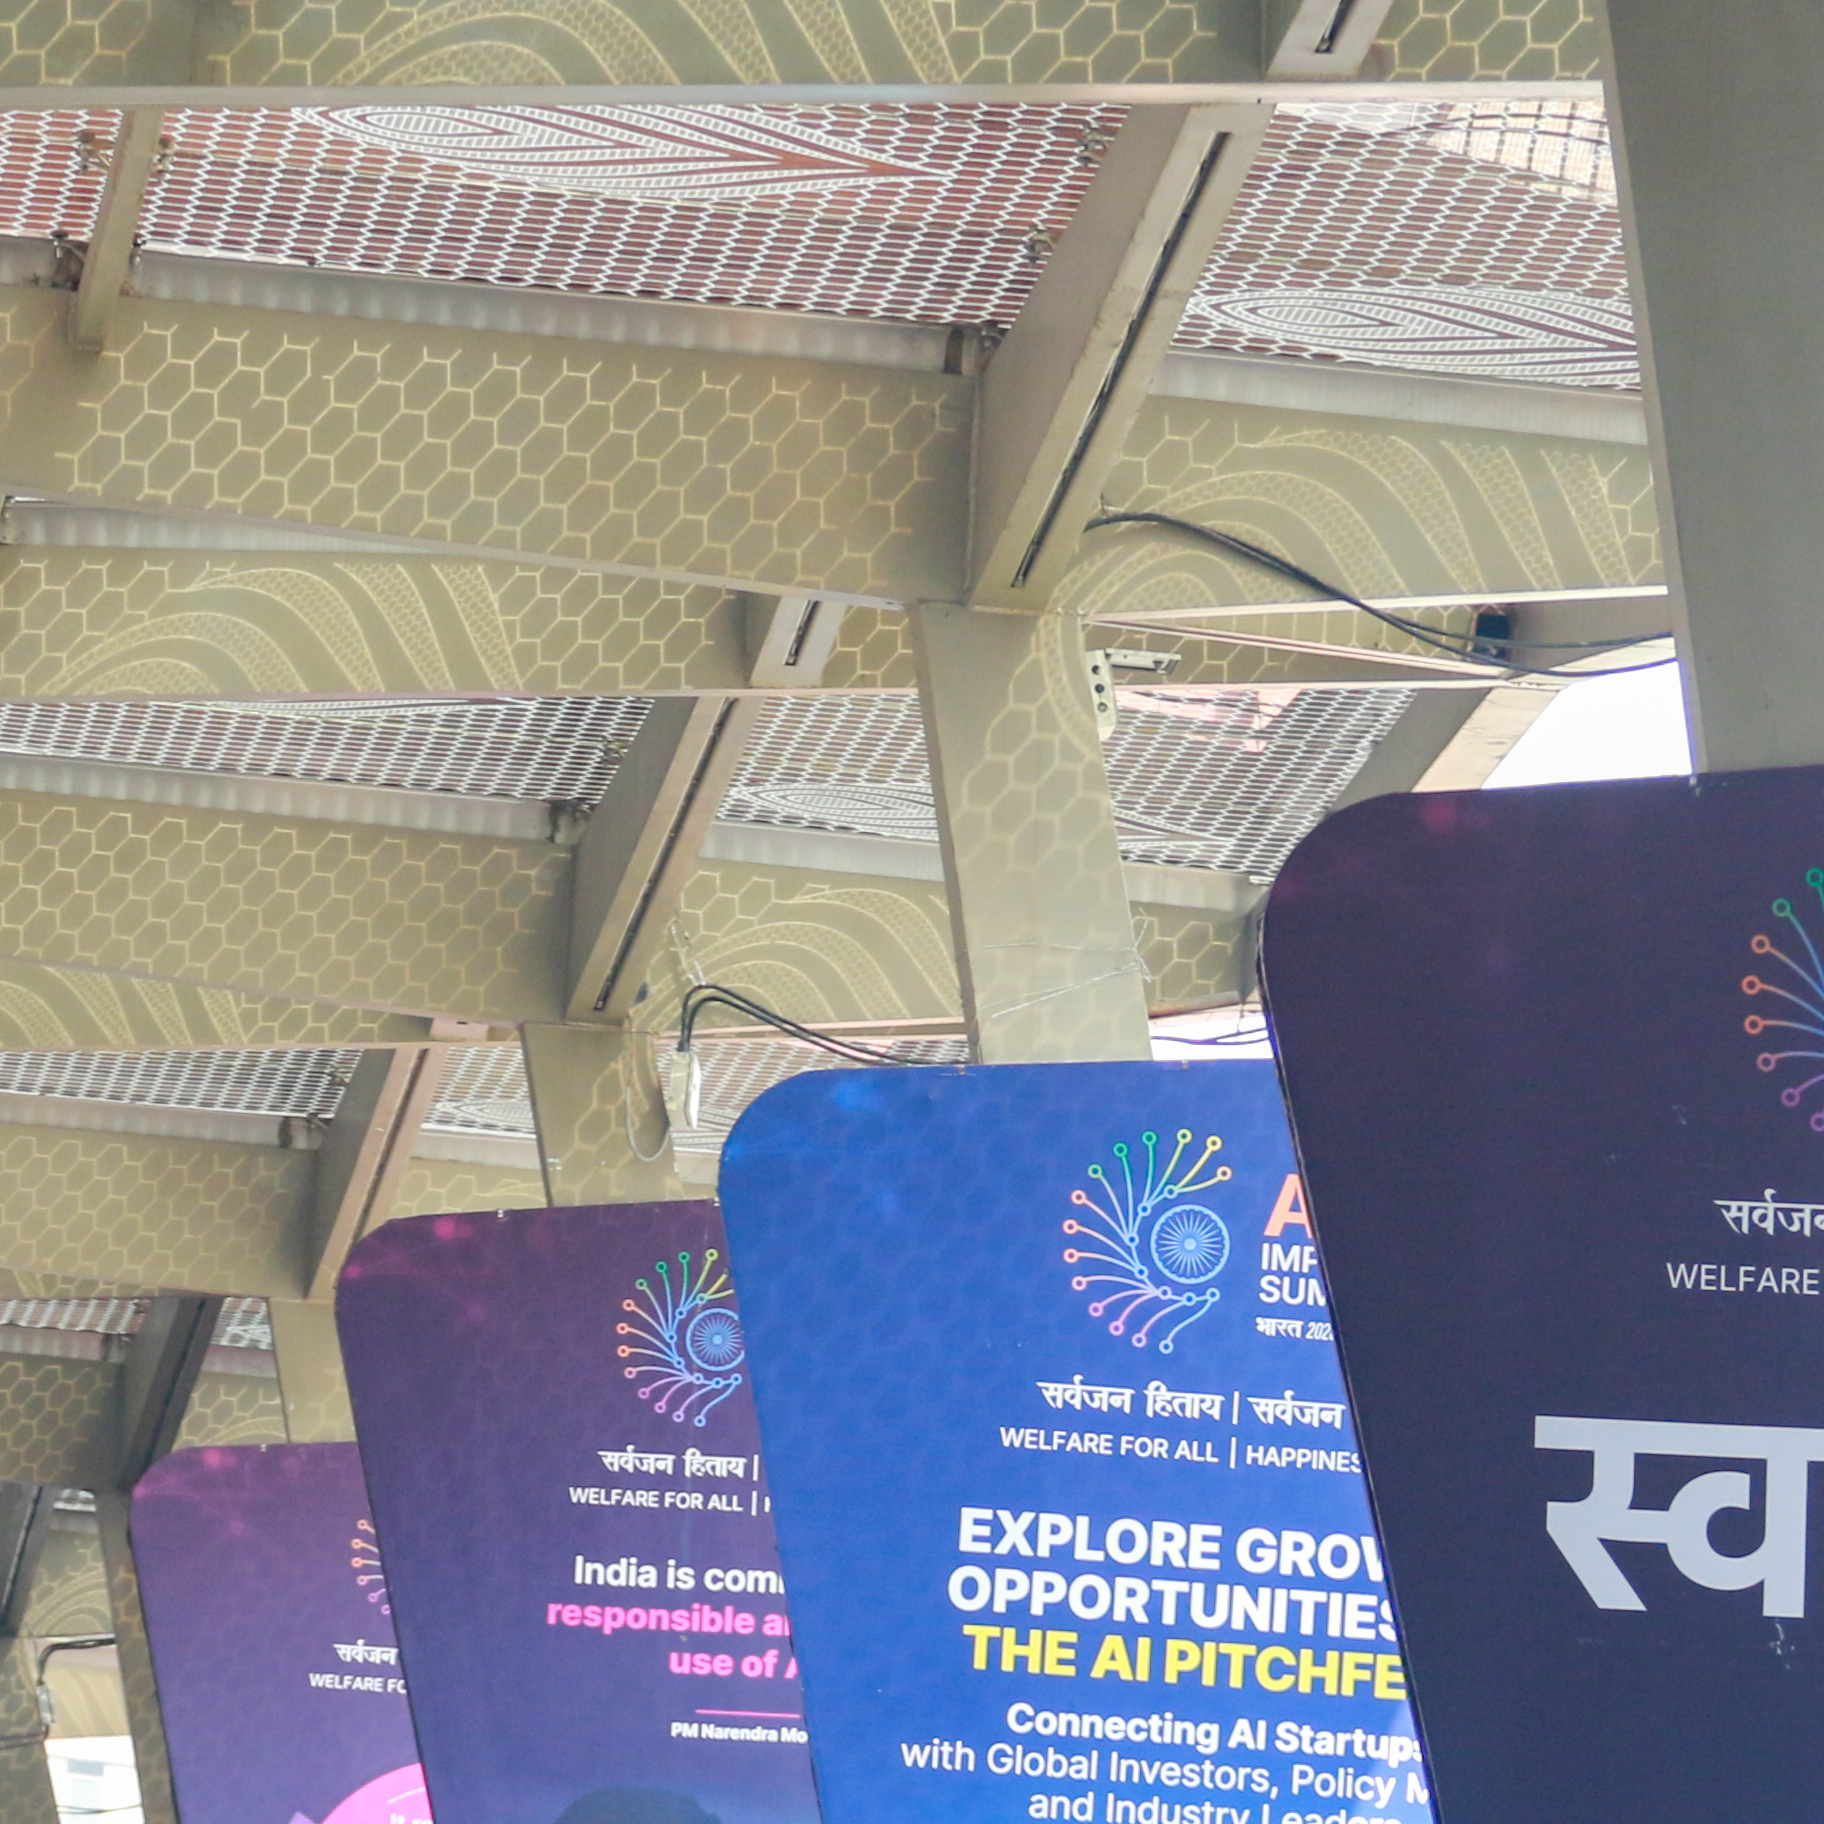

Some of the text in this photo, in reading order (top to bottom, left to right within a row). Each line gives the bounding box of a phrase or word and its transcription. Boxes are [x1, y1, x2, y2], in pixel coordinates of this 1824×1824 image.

[1666, 1262, 1821, 1297] WELFARE
[1255, 1316, 1303, 1340] भारत
[1037, 1374, 1346, 1430] सर्वजन हिताय सर्वजन
[597, 1444, 747, 1479] सर्वजन हिताय
[999, 1426, 1114, 1456] WELFARE
[1120, 1433, 1169, 1459] FOR
[1174, 1438, 1219, 1464] ALL
[569, 1486, 660, 1508] WELFARE
[664, 1491, 703, 1510] FOR
[707, 1493, 743, 1513] ALL
[958, 1506, 1223, 1571] EXPLORE
[574, 1555, 658, 1590] India
[666, 1558, 696, 1591] is
[547, 1602, 756, 1636] responsible
[668, 1649, 734, 1678] use
[740, 1649, 779, 1678] of
[962, 1624, 1408, 1701] THE AI PITCHFE
[308, 1673, 384, 1692] WELFARE
[671, 1721, 699, 1740] PM
[701, 1723, 776, 1744] Narendra
[1006, 1702, 1267, 1753] Connecting AI
[901, 1738, 1396, 1809] with Global Investors, Policy
[1029, 1790, 1096, 1822] and
